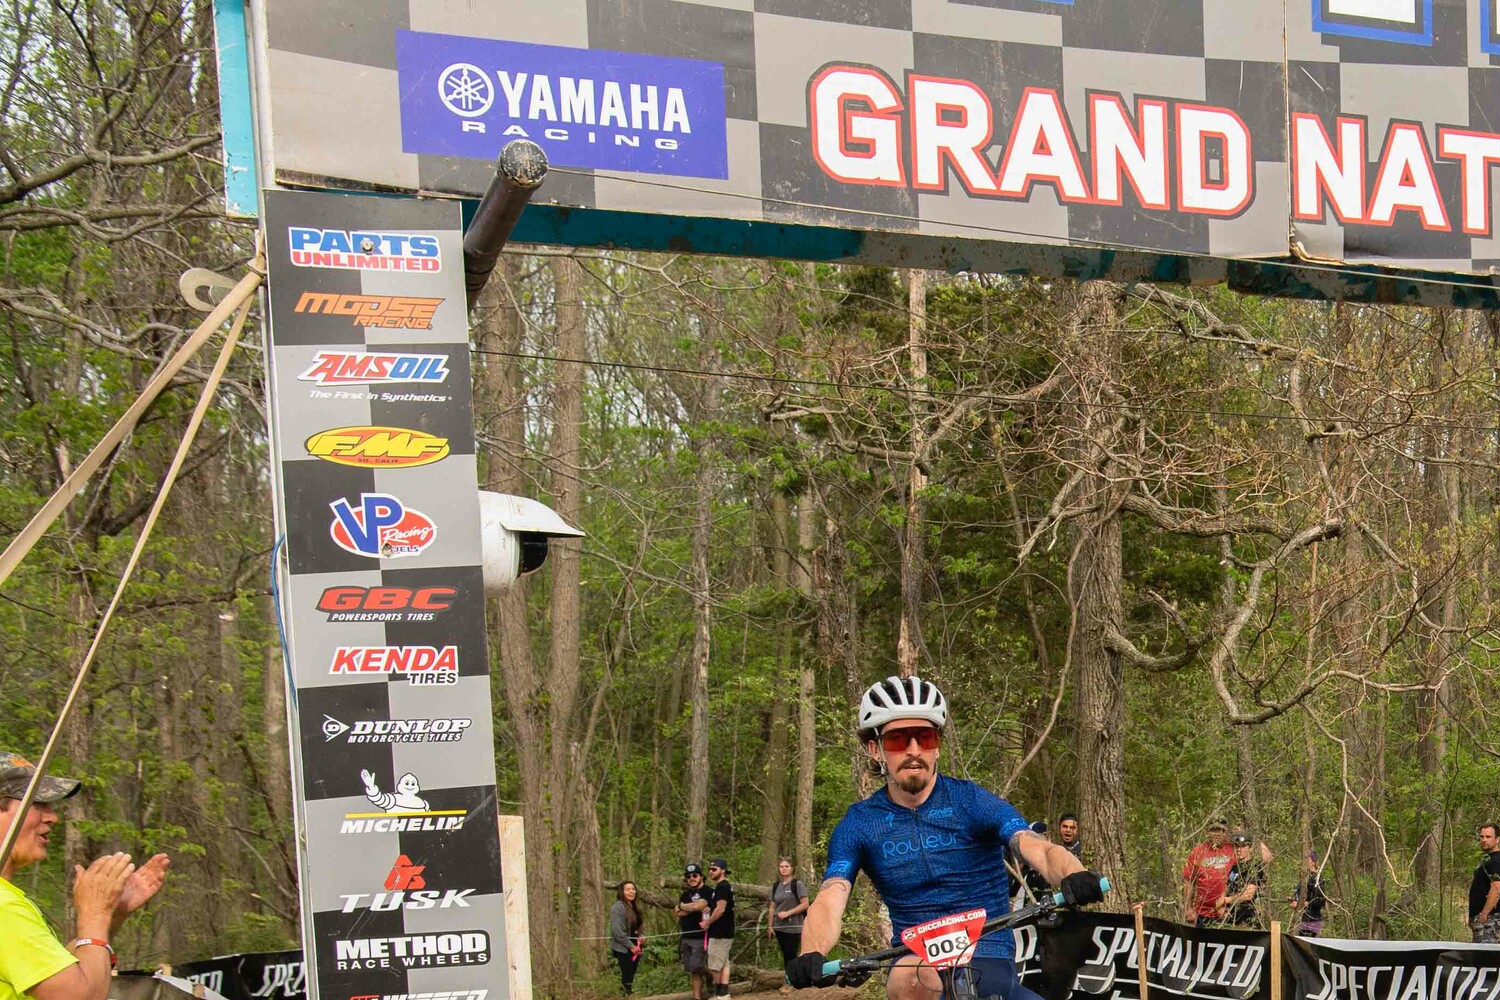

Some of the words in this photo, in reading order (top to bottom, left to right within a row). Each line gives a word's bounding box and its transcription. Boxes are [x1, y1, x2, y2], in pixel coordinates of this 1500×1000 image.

[497, 70, 692, 134] YAMAHA
[461, 120, 679, 150] RACING
[811, 66, 1253, 216] GRAND
[291, 229, 439, 257] PARTS
[292, 251, 440, 272] UNLIMITED
[294, 293, 446, 318] MOOSE
[353, 316, 431, 329] RACING
[306, 354, 444, 382] AMSOIL
[309, 390, 332, 399] The
[335, 390, 363, 399] First
[366, 392, 379, 400] in
[381, 391, 446, 402] Synthetics
[309, 433, 449, 458] FMF
[334, 497, 402, 554] VP
[383, 525, 438, 544] Racing
[389, 545, 419, 553] UELS
[319, 587, 457, 611] GBC
[331, 613, 402, 621] POWERSPORTS
[407, 613, 435, 621] TIRES
[332, 648, 458, 673] KENDA
[409, 672, 457, 684] TIRES
[347, 734, 423, 743] MOTORCYCLE
[428, 732, 462, 742] TIRES
[350, 719, 472, 735] DUNLOP
[340, 816, 466, 834] MICHELIN
[882, 832, 957, 859] Rouleur
[339, 888, 477, 914] TUSK
[917, 909, 987, 935] GNCCRACING.COM
[336, 932, 488, 960] METHOD
[928, 936, 968, 957] 008
[1085, 925, 1266, 988] SPECIALIZED
[338, 957, 390, 970] RACE
[402, 953, 488, 967] WHEELS
